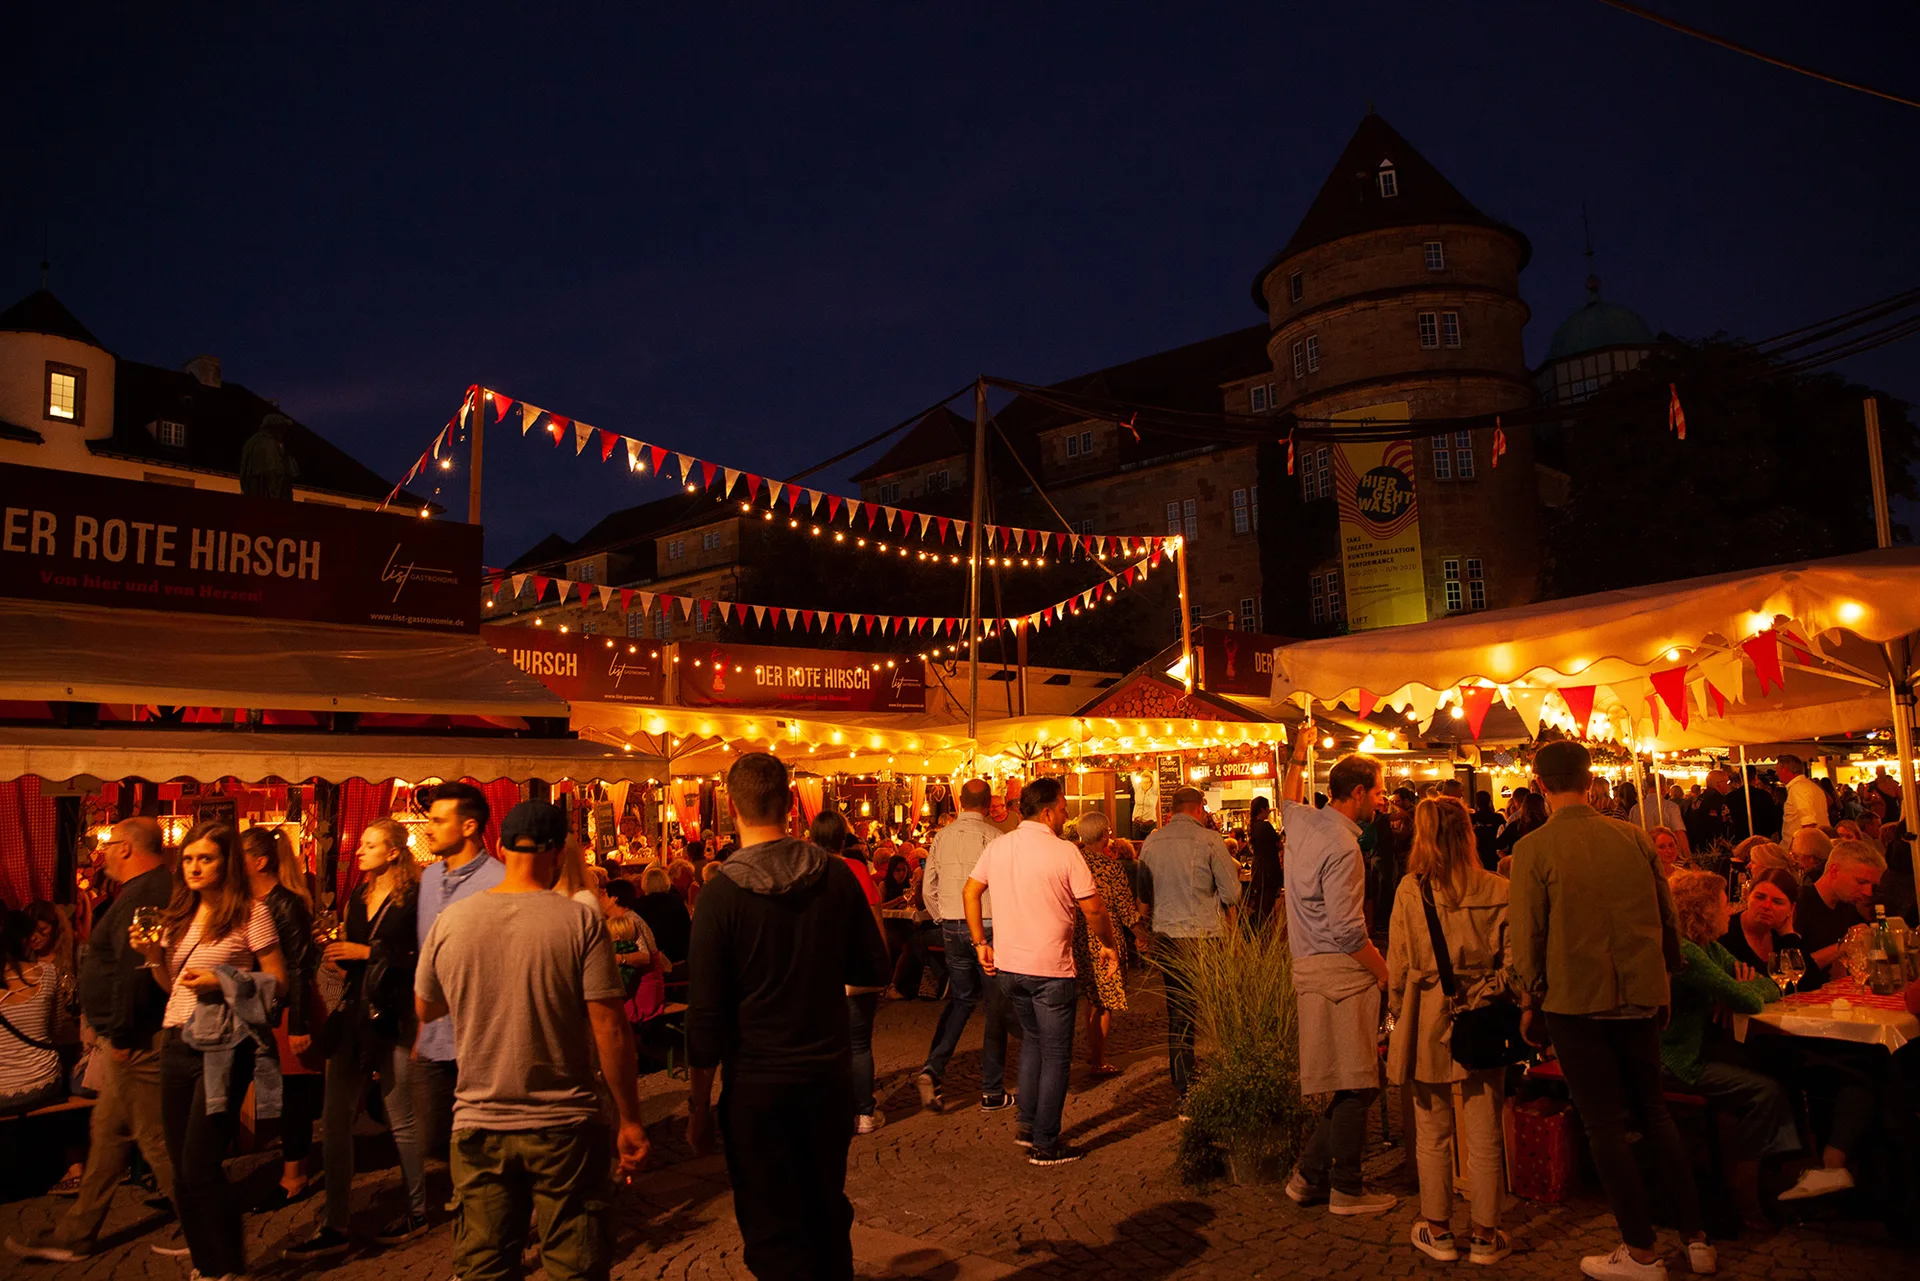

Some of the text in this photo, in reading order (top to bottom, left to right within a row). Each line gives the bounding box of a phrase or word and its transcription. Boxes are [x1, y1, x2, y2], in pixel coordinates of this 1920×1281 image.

[1361, 475, 1397, 491] HIER
[1372, 488, 1413, 505] GEHT
[1358, 498, 1399, 515] WAS!
[73, 515, 178, 567] ROTE
[190, 528, 321, 581] HIRSCH
[1347, 543, 1373, 552] THEATER
[1347, 546, 1416, 560] KUNSTINSTALLATION
[1348, 557, 1395, 568] PERFORMANCE
[40, 570, 77, 587] Von
[125, 579, 160, 594] und
[164, 584, 195, 598] von
[410, 574, 459, 585] GASTRONOMIE
[370, 612, 465, 627] www.list-gastronomie.de
[1352, 616, 1368, 624] LIFT
[513, 649, 577, 677] HIRSCH
[1254, 651, 1273, 674] DER
[756, 664, 871, 690] DER ROTE HIRSCH
[1215, 764, 1222, 776] &
